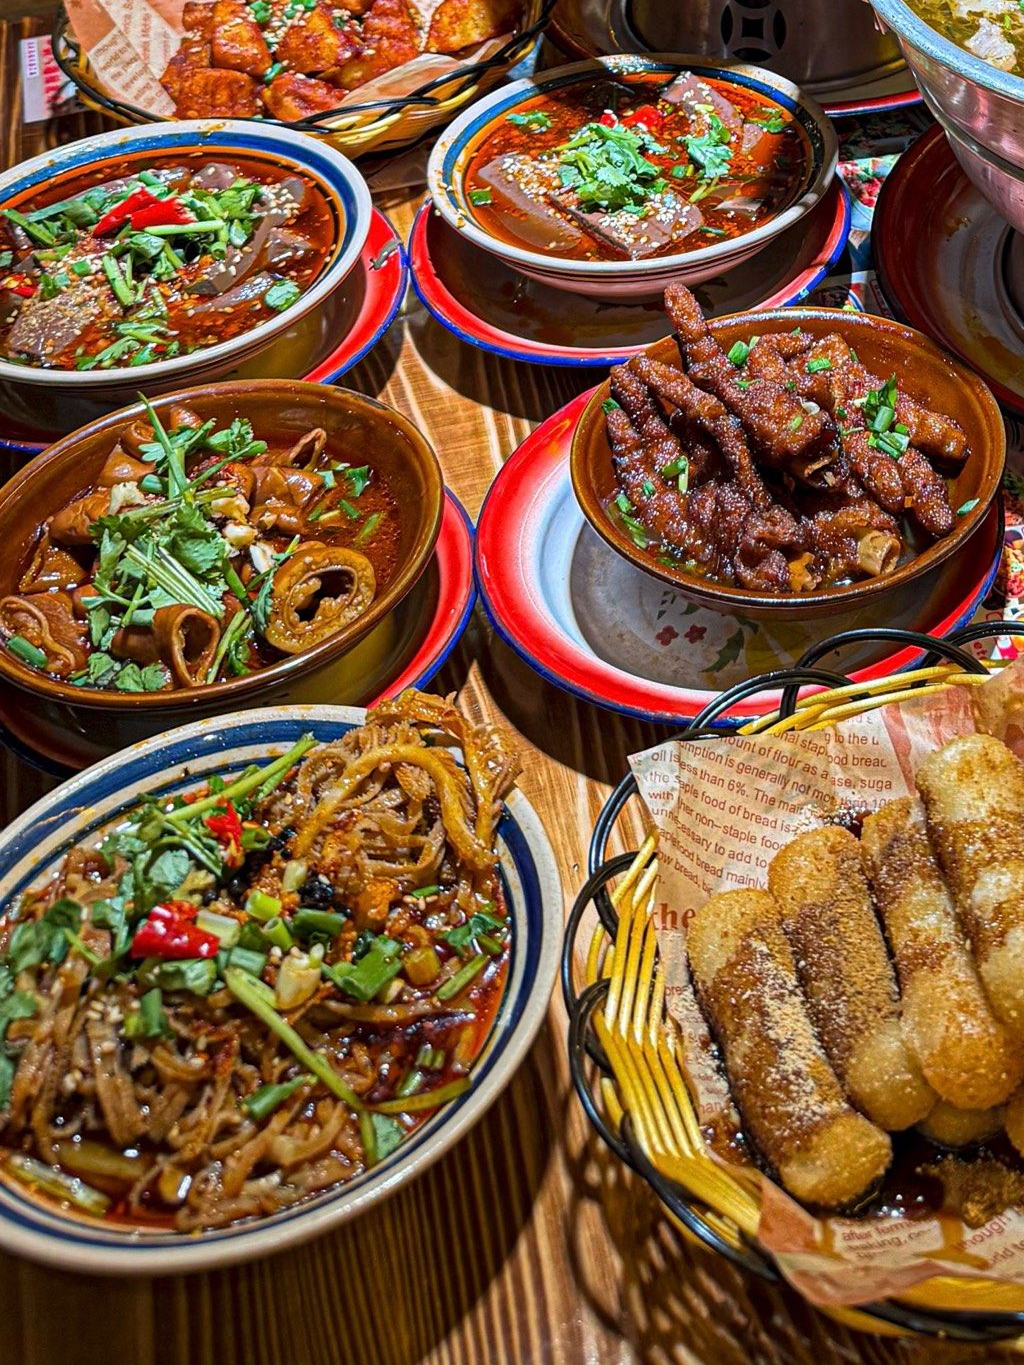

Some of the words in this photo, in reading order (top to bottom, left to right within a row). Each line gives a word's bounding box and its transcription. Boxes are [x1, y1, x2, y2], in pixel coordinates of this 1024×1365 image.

[650, 749, 667, 763] oil
[847, 732, 869, 746] the
[723, 753, 736, 769] is
[735, 761, 791, 791] generally
[790, 780, 813, 797] not
[758, 743, 772, 758] of
[771, 747, 802, 771] flour
[802, 762, 819, 777] as
[820, 769, 830, 780] a
[647, 788, 675, 802] with
[649, 770, 671, 785] the
[700, 790, 727, 812] food
[727, 802, 743, 818] of
[742, 809, 778, 831] bread
[780, 819, 793, 835] is
[699, 769, 726, 788] than
[727, 779, 750, 800] 6%.
[753, 787, 777, 807] The
[713, 840, 727, 857] to
[727, 848, 754, 866] add
[754, 855, 768, 870] to
[695, 856, 725, 879] bread
[725, 870, 767, 891] mainly
